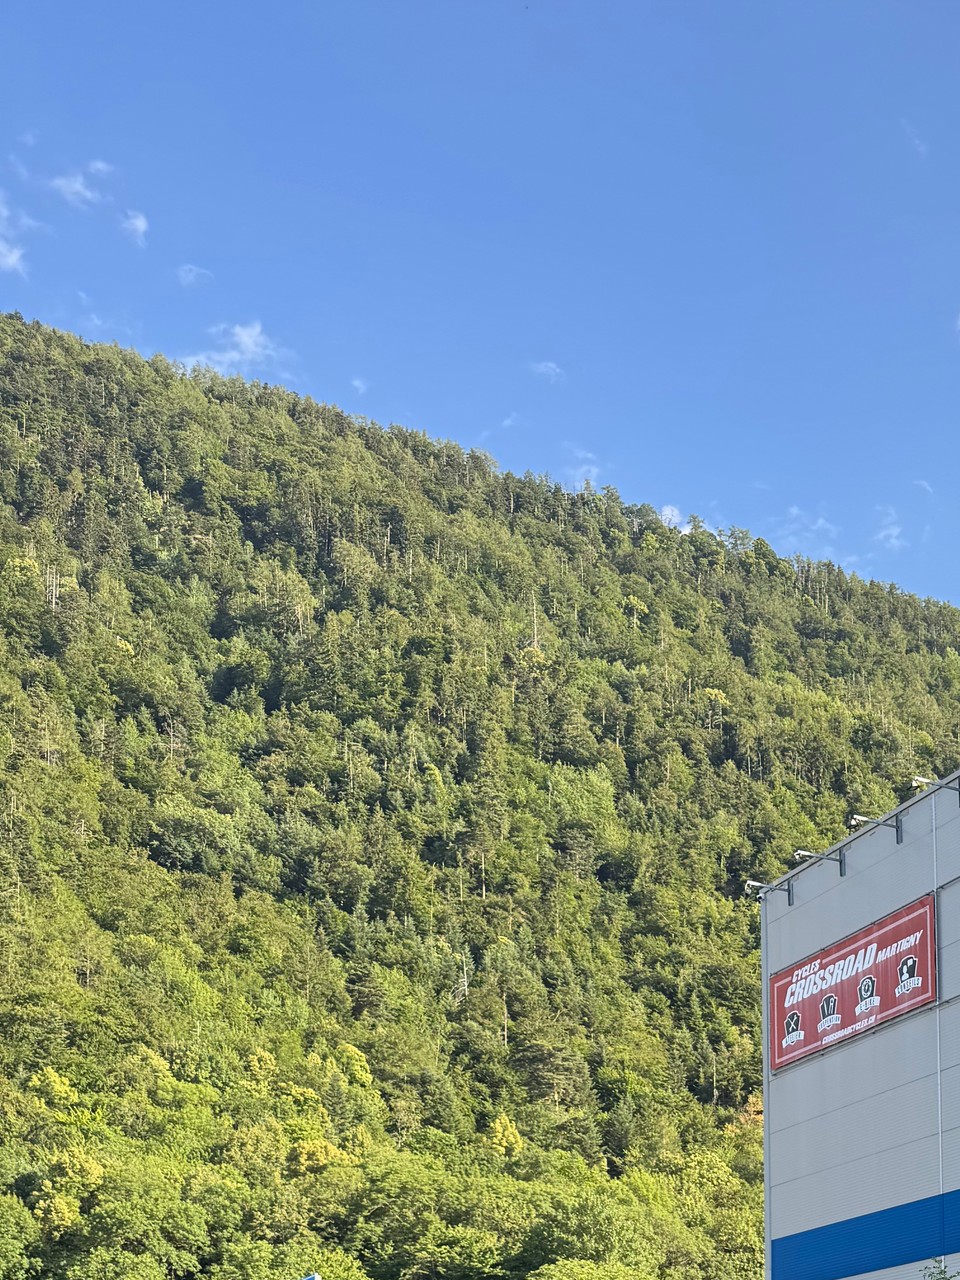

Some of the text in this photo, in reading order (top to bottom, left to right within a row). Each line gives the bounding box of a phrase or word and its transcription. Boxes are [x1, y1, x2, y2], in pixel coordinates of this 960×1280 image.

[784, 929, 923, 1008] CROSSROAD MARTIGNY
[792, 959, 821, 983] CYCLES
